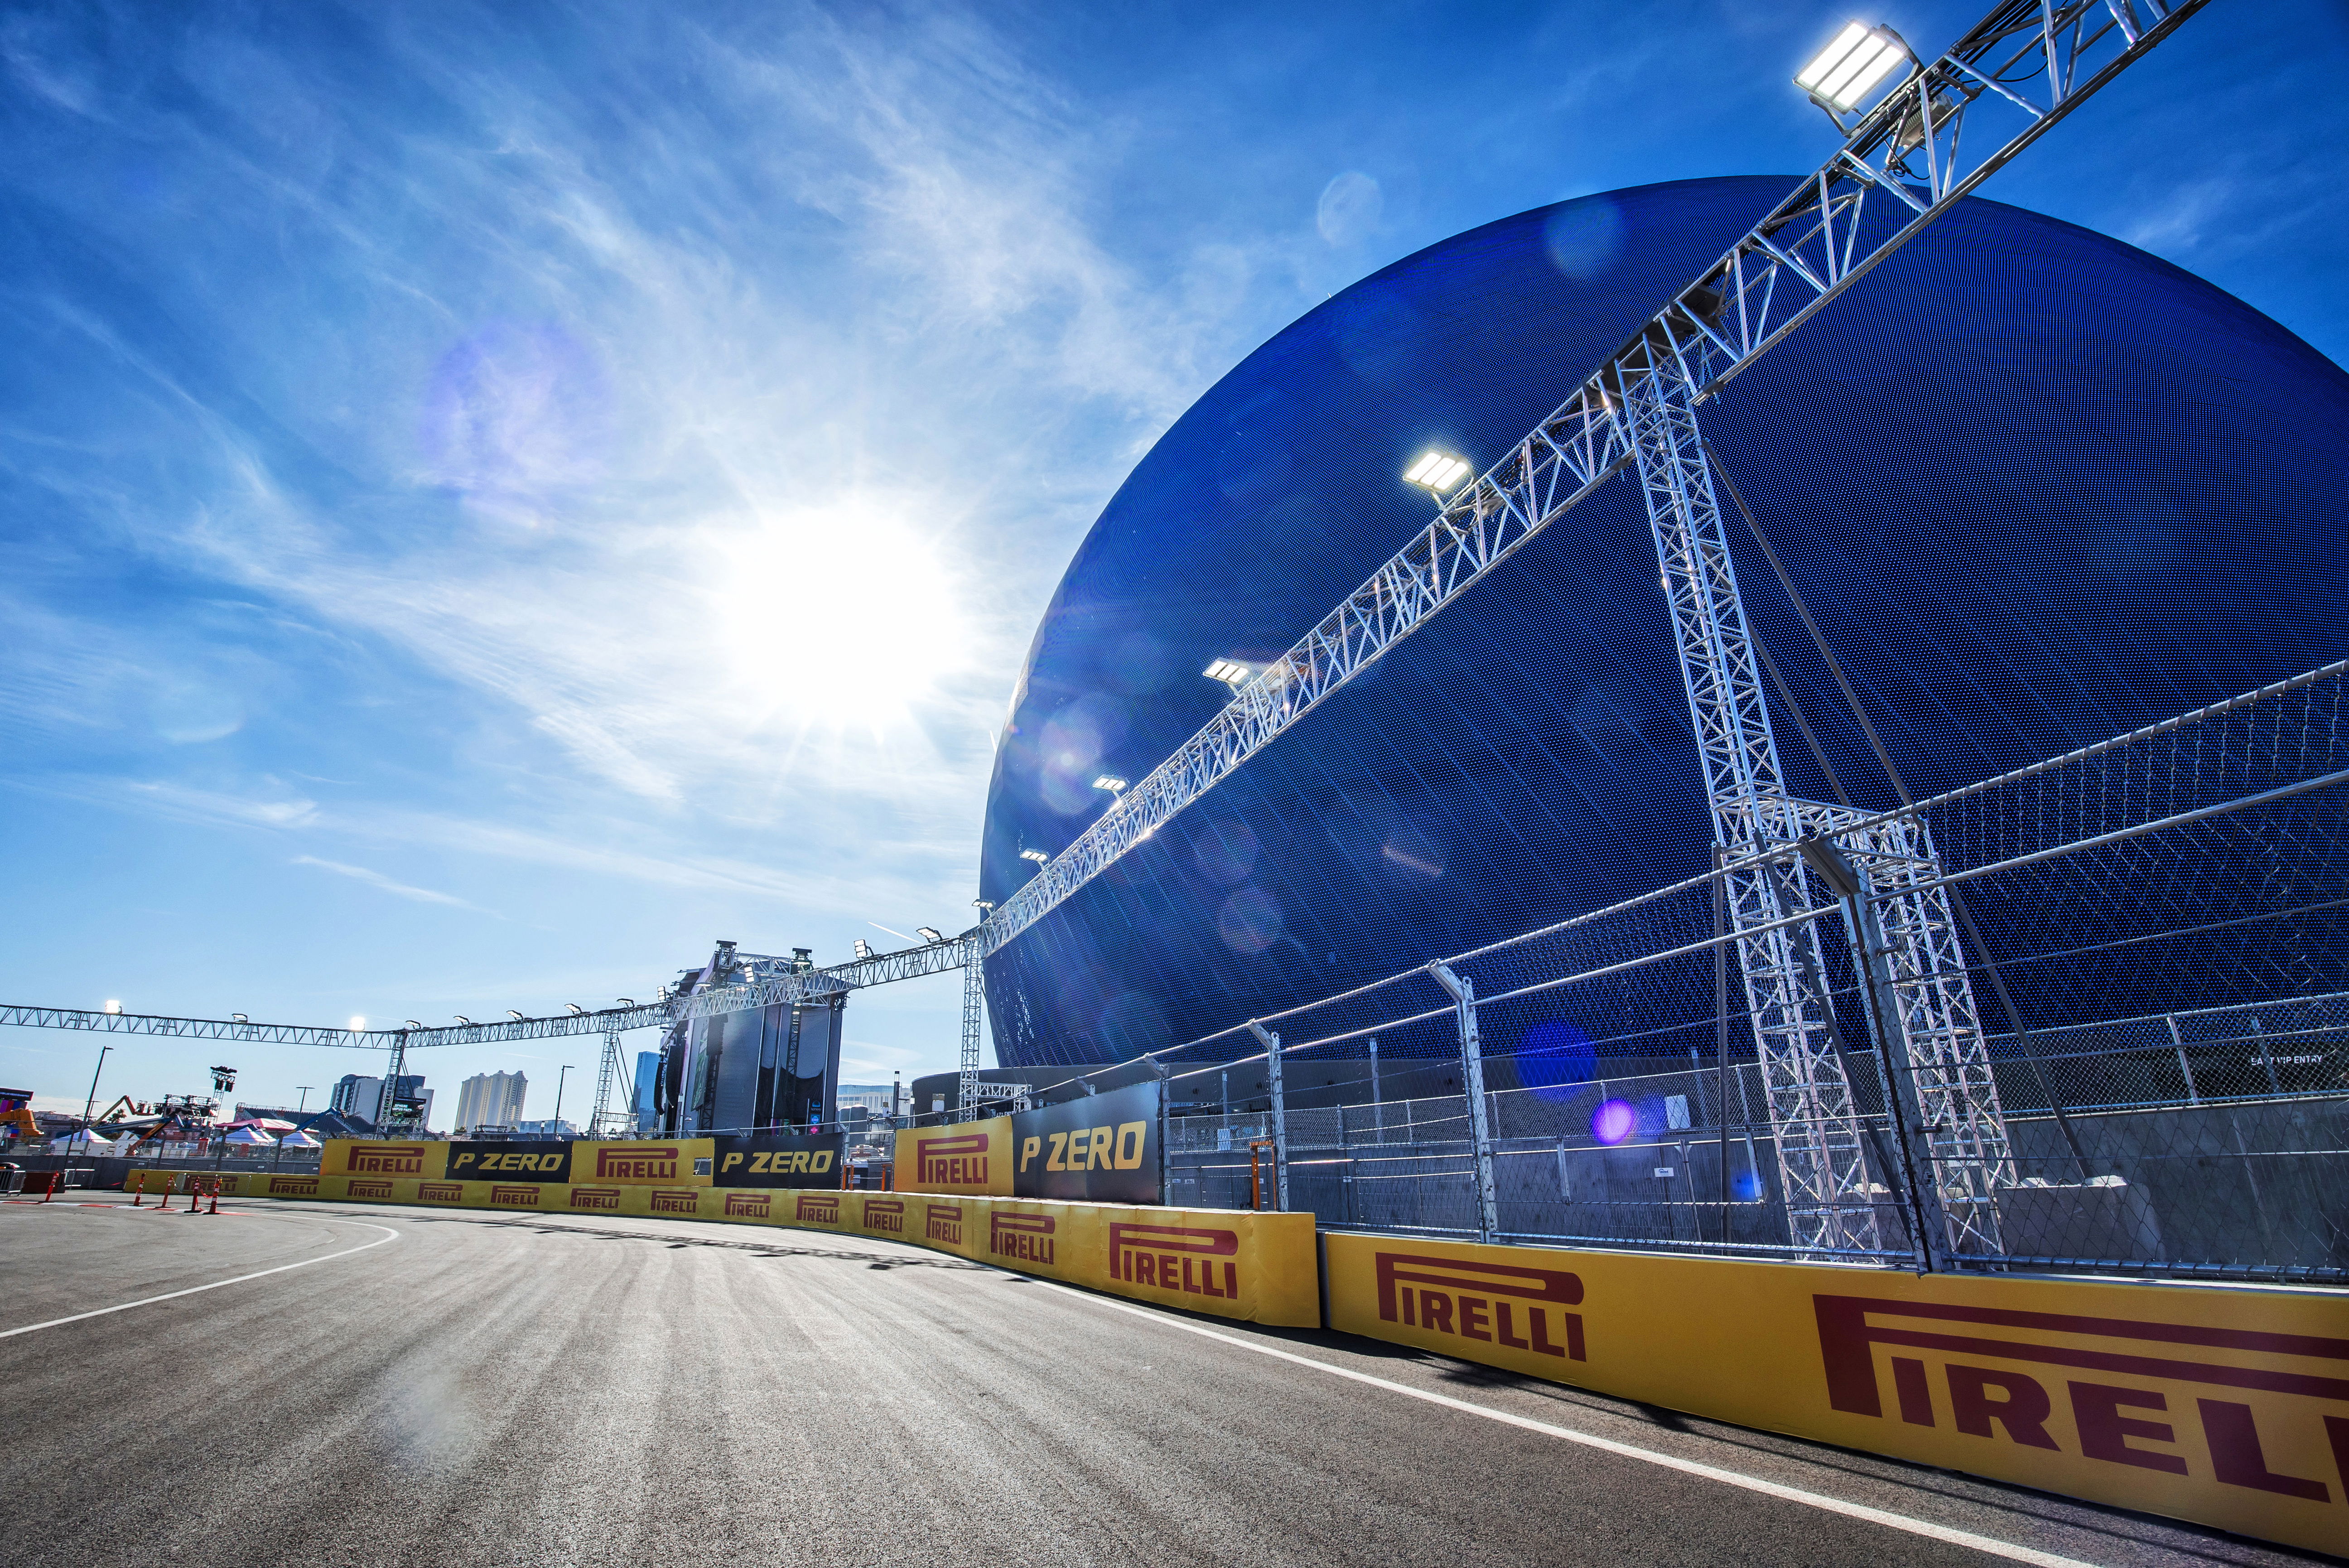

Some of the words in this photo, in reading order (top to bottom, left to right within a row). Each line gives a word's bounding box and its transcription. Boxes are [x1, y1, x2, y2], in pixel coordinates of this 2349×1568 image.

[2251, 1057, 2275, 1065] EAT
[2295, 1055, 2323, 1064] ENTRY
[347, 1146, 425, 1173] PIRELLI
[917, 1134, 989, 1184] PIRELLI
[1020, 1136, 1041, 1172] P
[1046, 1121, 1147, 1172] ZERO
[453, 1153, 475, 1169] P
[478, 1153, 564, 1171] ZERO
[596, 1148, 679, 1178] PIRELLI
[721, 1153, 743, 1172] P
[748, 1150, 834, 1173] ZERO
[269, 1177, 319, 1194] PIRELLI
[347, 1180, 393, 1198] PIRELLI
[418, 1183, 463, 1201] PIRELLI
[491, 1186, 540, 1205] PIRELLI
[570, 1188, 620, 1208] PIRELLI
[651, 1190, 698, 1213] PIRELLI
[725, 1193, 771, 1218] PIRELLI
[796, 1196, 839, 1224] PIRELLI
[863, 1199, 904, 1232] PIRELLI
[926, 1204, 962, 1245] PIRELLI
[990, 1211, 1056, 1265] PIRELLI
[1109, 1222, 1238, 1299] PIRELLI
[1375, 1252, 1587, 1363] PIRELLI
[1813, 1294, 2349, 1507] PIREL
